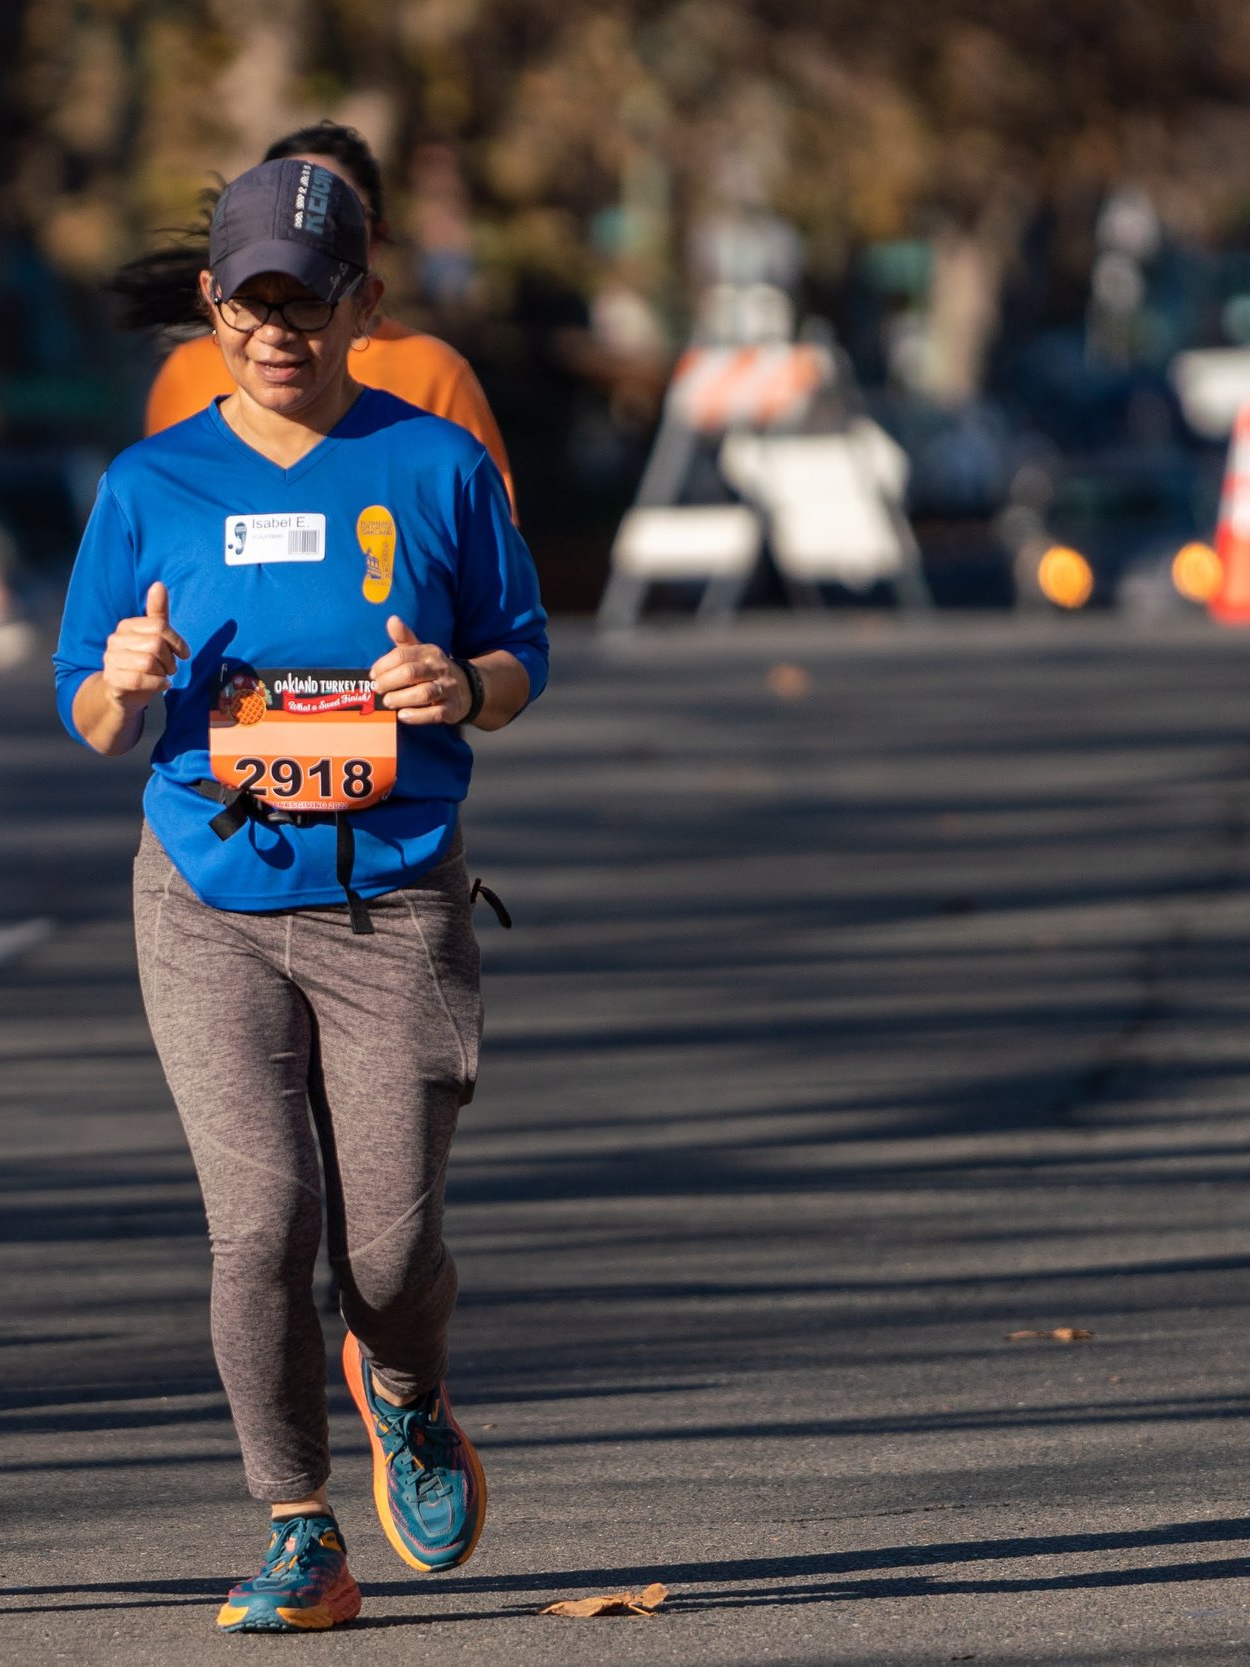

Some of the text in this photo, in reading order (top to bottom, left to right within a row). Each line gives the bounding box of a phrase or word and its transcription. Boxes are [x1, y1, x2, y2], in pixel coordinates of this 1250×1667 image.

[252, 517, 291, 529] Isabel
[274, 672, 318, 695] OAKLAND
[320, 679, 356, 694] TURKEY
[287, 701, 311, 712] What
[318, 699, 340, 711] Sweet
[341, 693, 372, 705] Finish!
[234, 756, 374, 799] 2918
